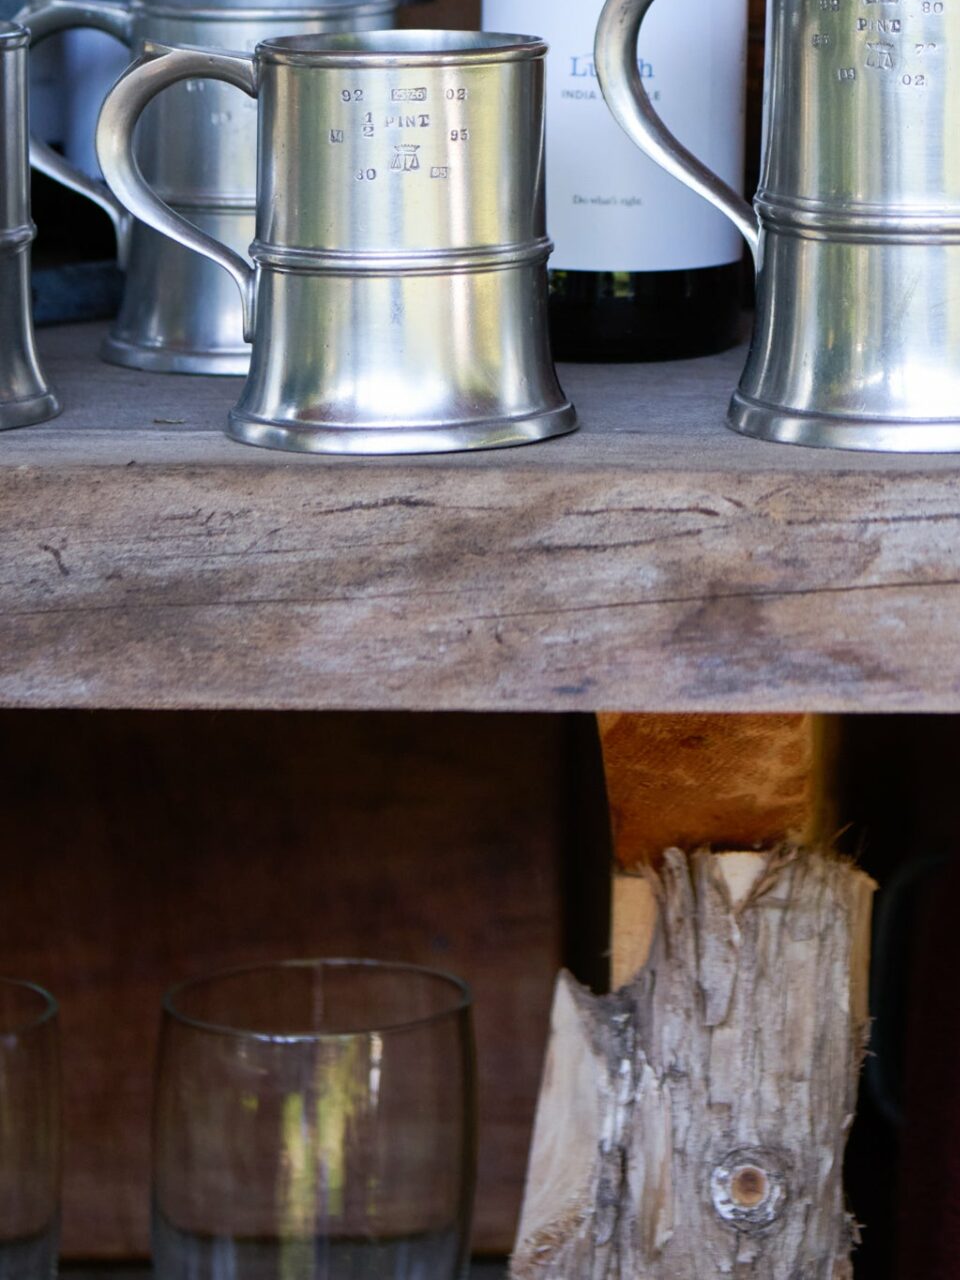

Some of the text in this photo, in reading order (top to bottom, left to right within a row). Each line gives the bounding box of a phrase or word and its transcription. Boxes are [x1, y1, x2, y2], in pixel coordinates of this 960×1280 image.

[921, 1, 944, 15] 80
[857, 17, 902, 33] PINT
[902, 73, 926, 87] 02
[341, 88, 364, 103] 92
[446, 87, 467, 101] 02
[561, 89, 597, 101] INDIA
[384, 113, 431, 128] PINT
[450, 127, 469, 142] 95
